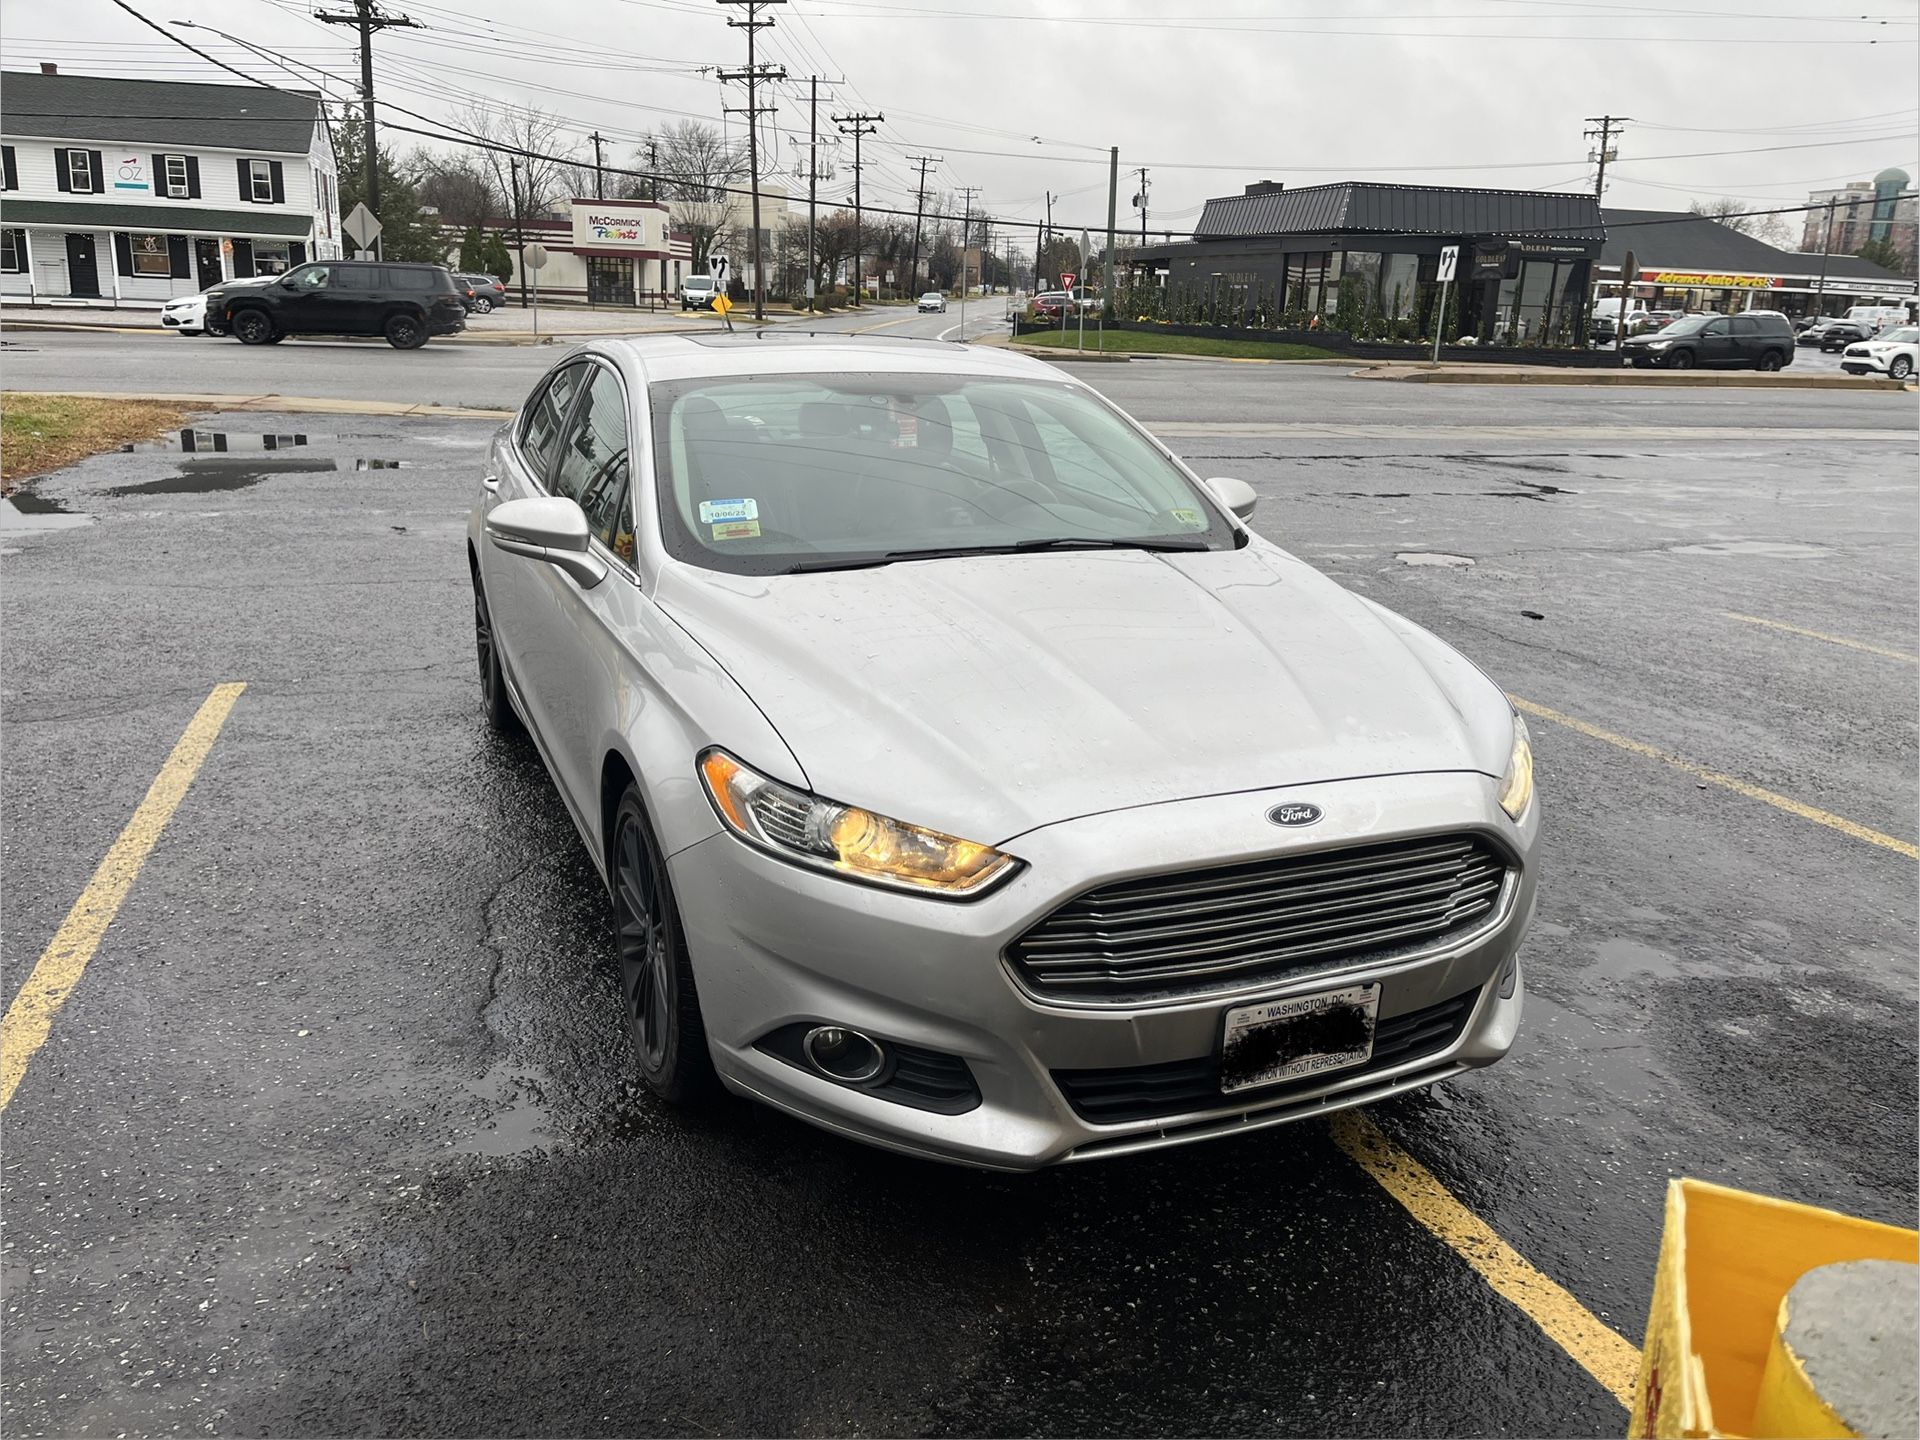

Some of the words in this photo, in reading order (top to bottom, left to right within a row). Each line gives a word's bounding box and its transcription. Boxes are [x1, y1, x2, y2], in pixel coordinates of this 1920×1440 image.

[592, 226, 637, 240] Paints
[1655, 273, 1702, 284] Advance
[1703, 275, 1732, 285] Auto
[1280, 806, 1313, 822] Ford
[1332, 994, 1344, 1005] DC
[1279, 1061, 1310, 1076] WITHOUT
